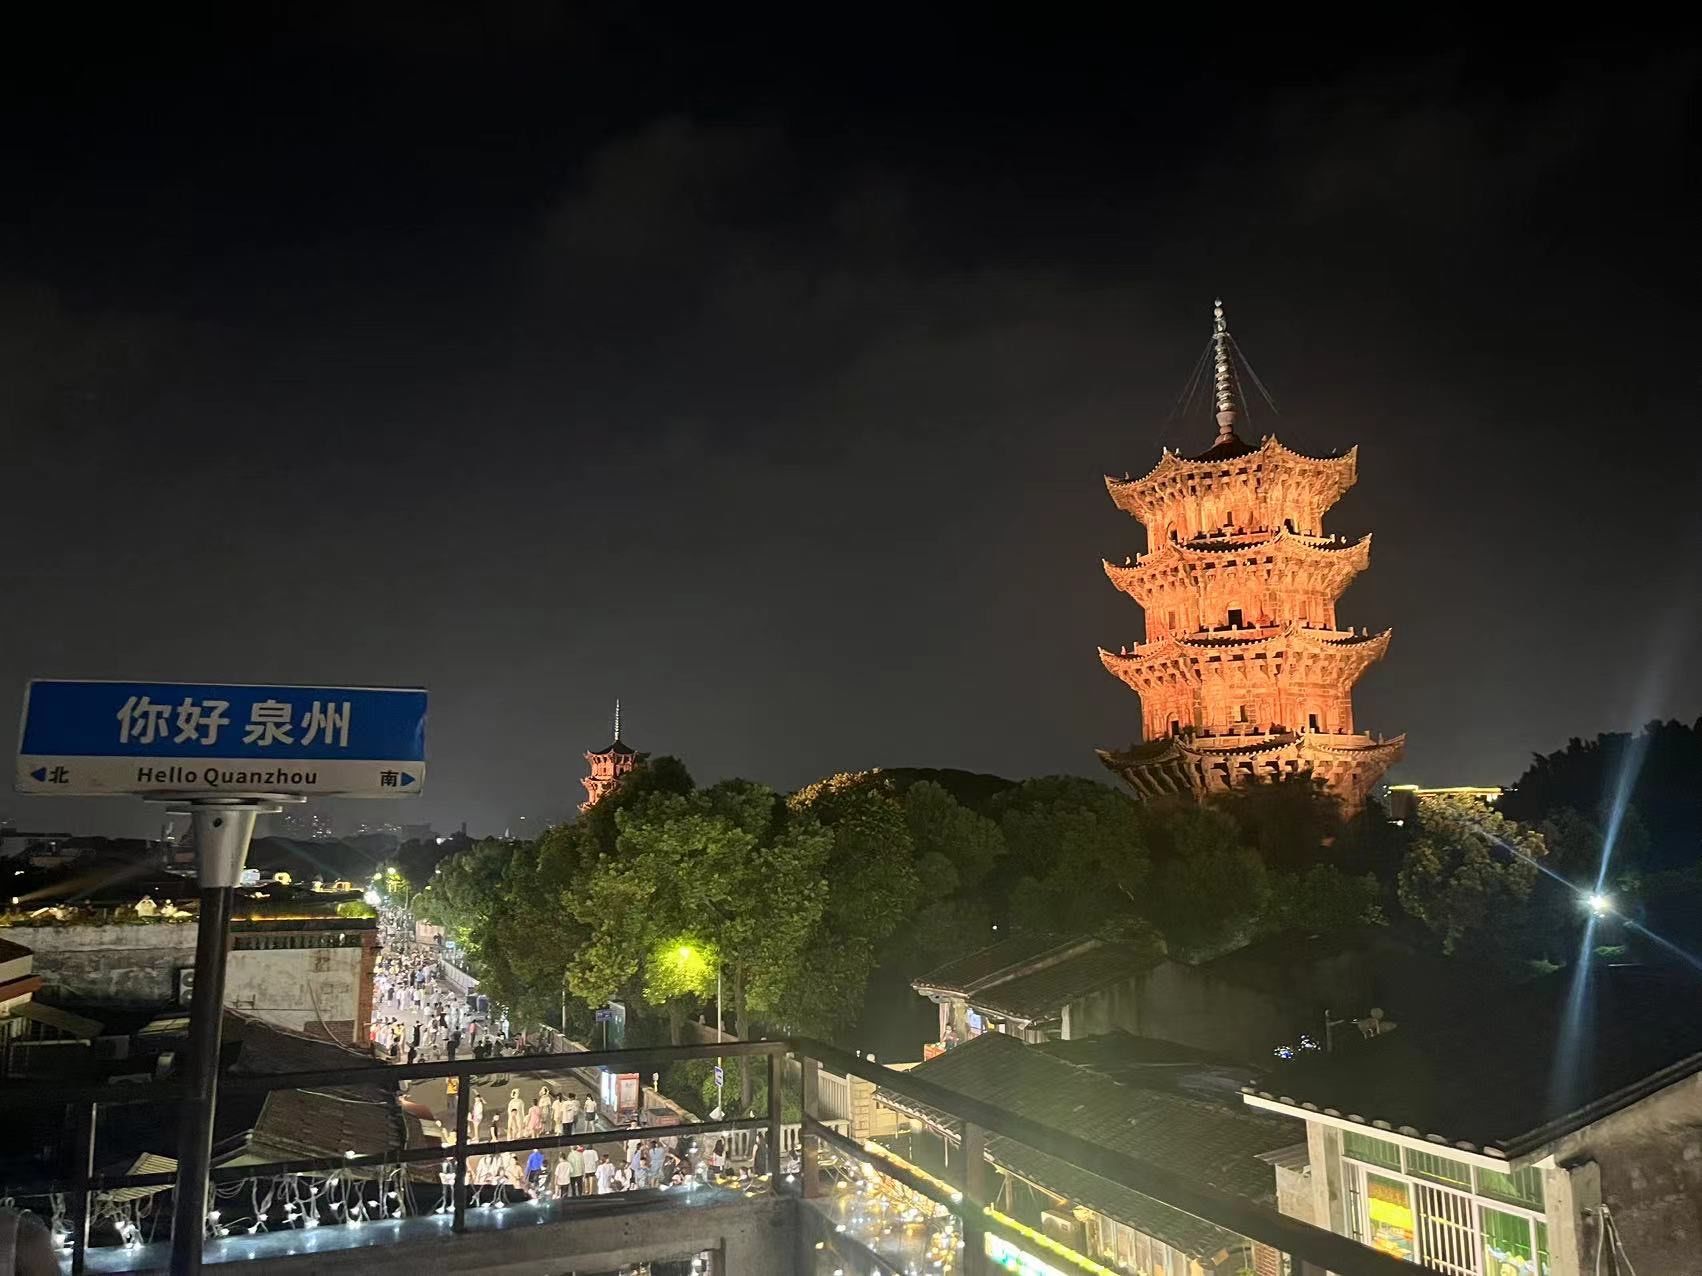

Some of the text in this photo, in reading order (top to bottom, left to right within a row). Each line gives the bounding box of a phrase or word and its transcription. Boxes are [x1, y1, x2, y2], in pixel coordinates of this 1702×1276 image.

[116, 695, 352, 747] 你好 泉州
[48, 766, 70, 784] 北
[137, 767, 318, 786] Hello Quanzhou
[380, 770, 399, 788] 南
